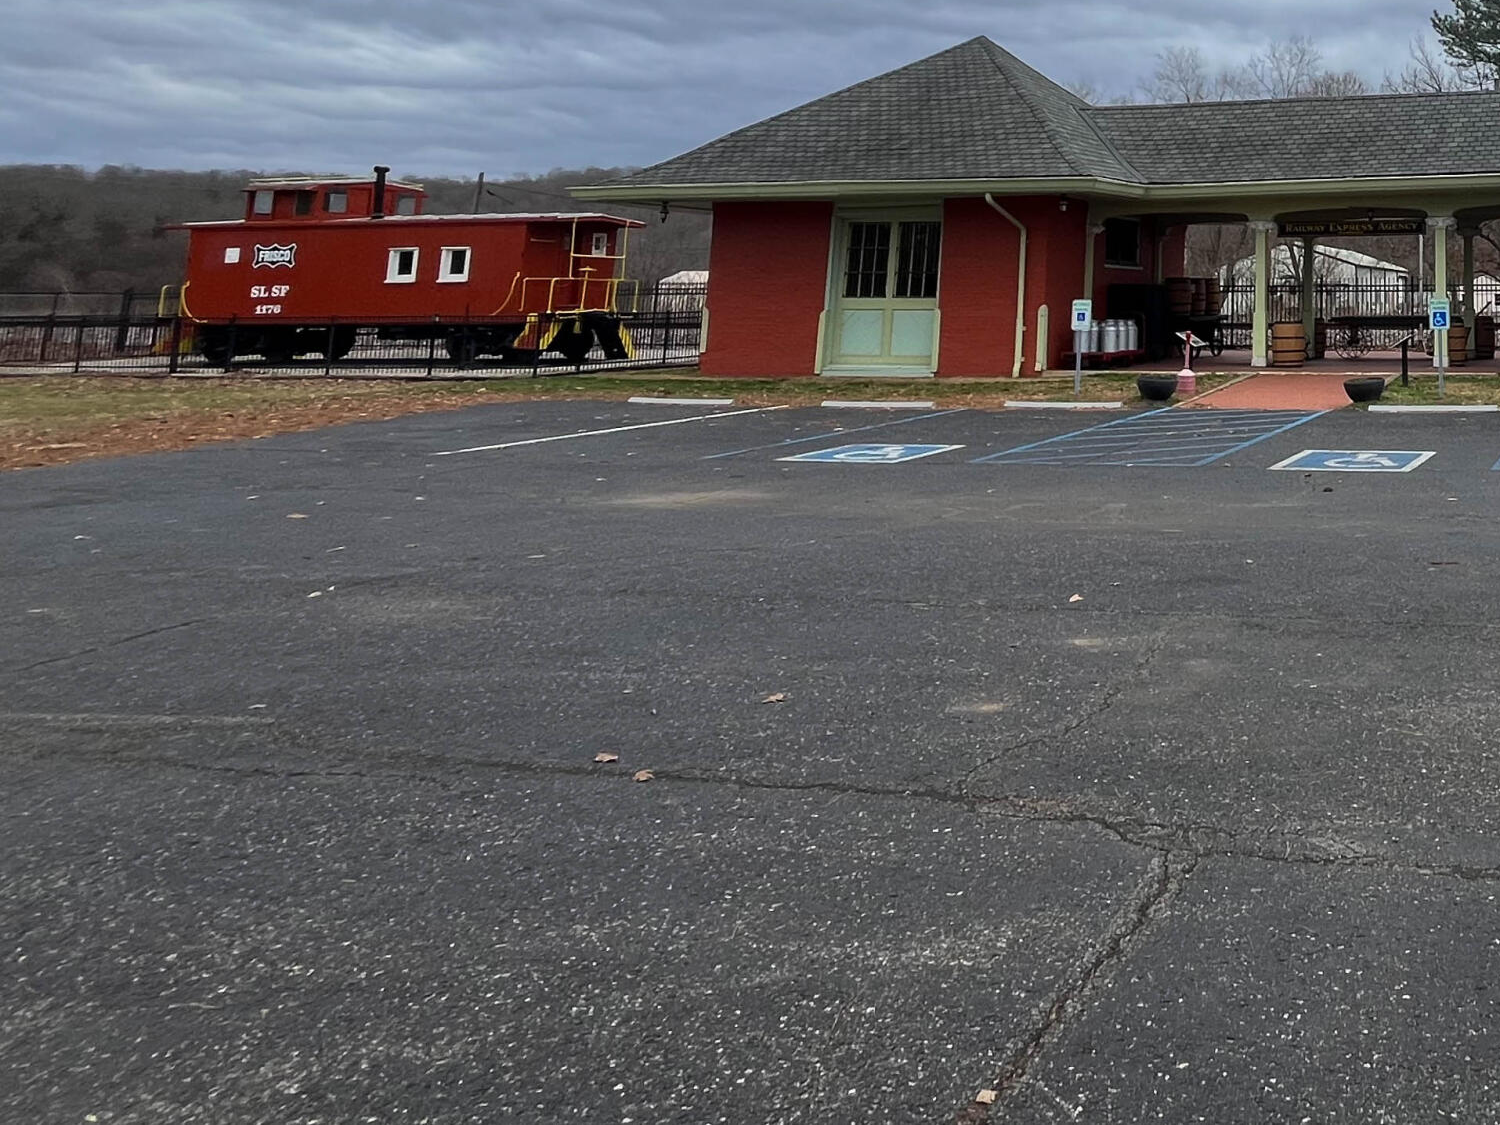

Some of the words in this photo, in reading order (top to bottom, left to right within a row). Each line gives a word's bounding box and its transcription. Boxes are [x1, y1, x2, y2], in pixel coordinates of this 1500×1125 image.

[258, 250, 291, 262] FRISCO
[250, 285, 269, 298] SL
[271, 285, 290, 297] SF
[255, 304, 281, 314] 1176
